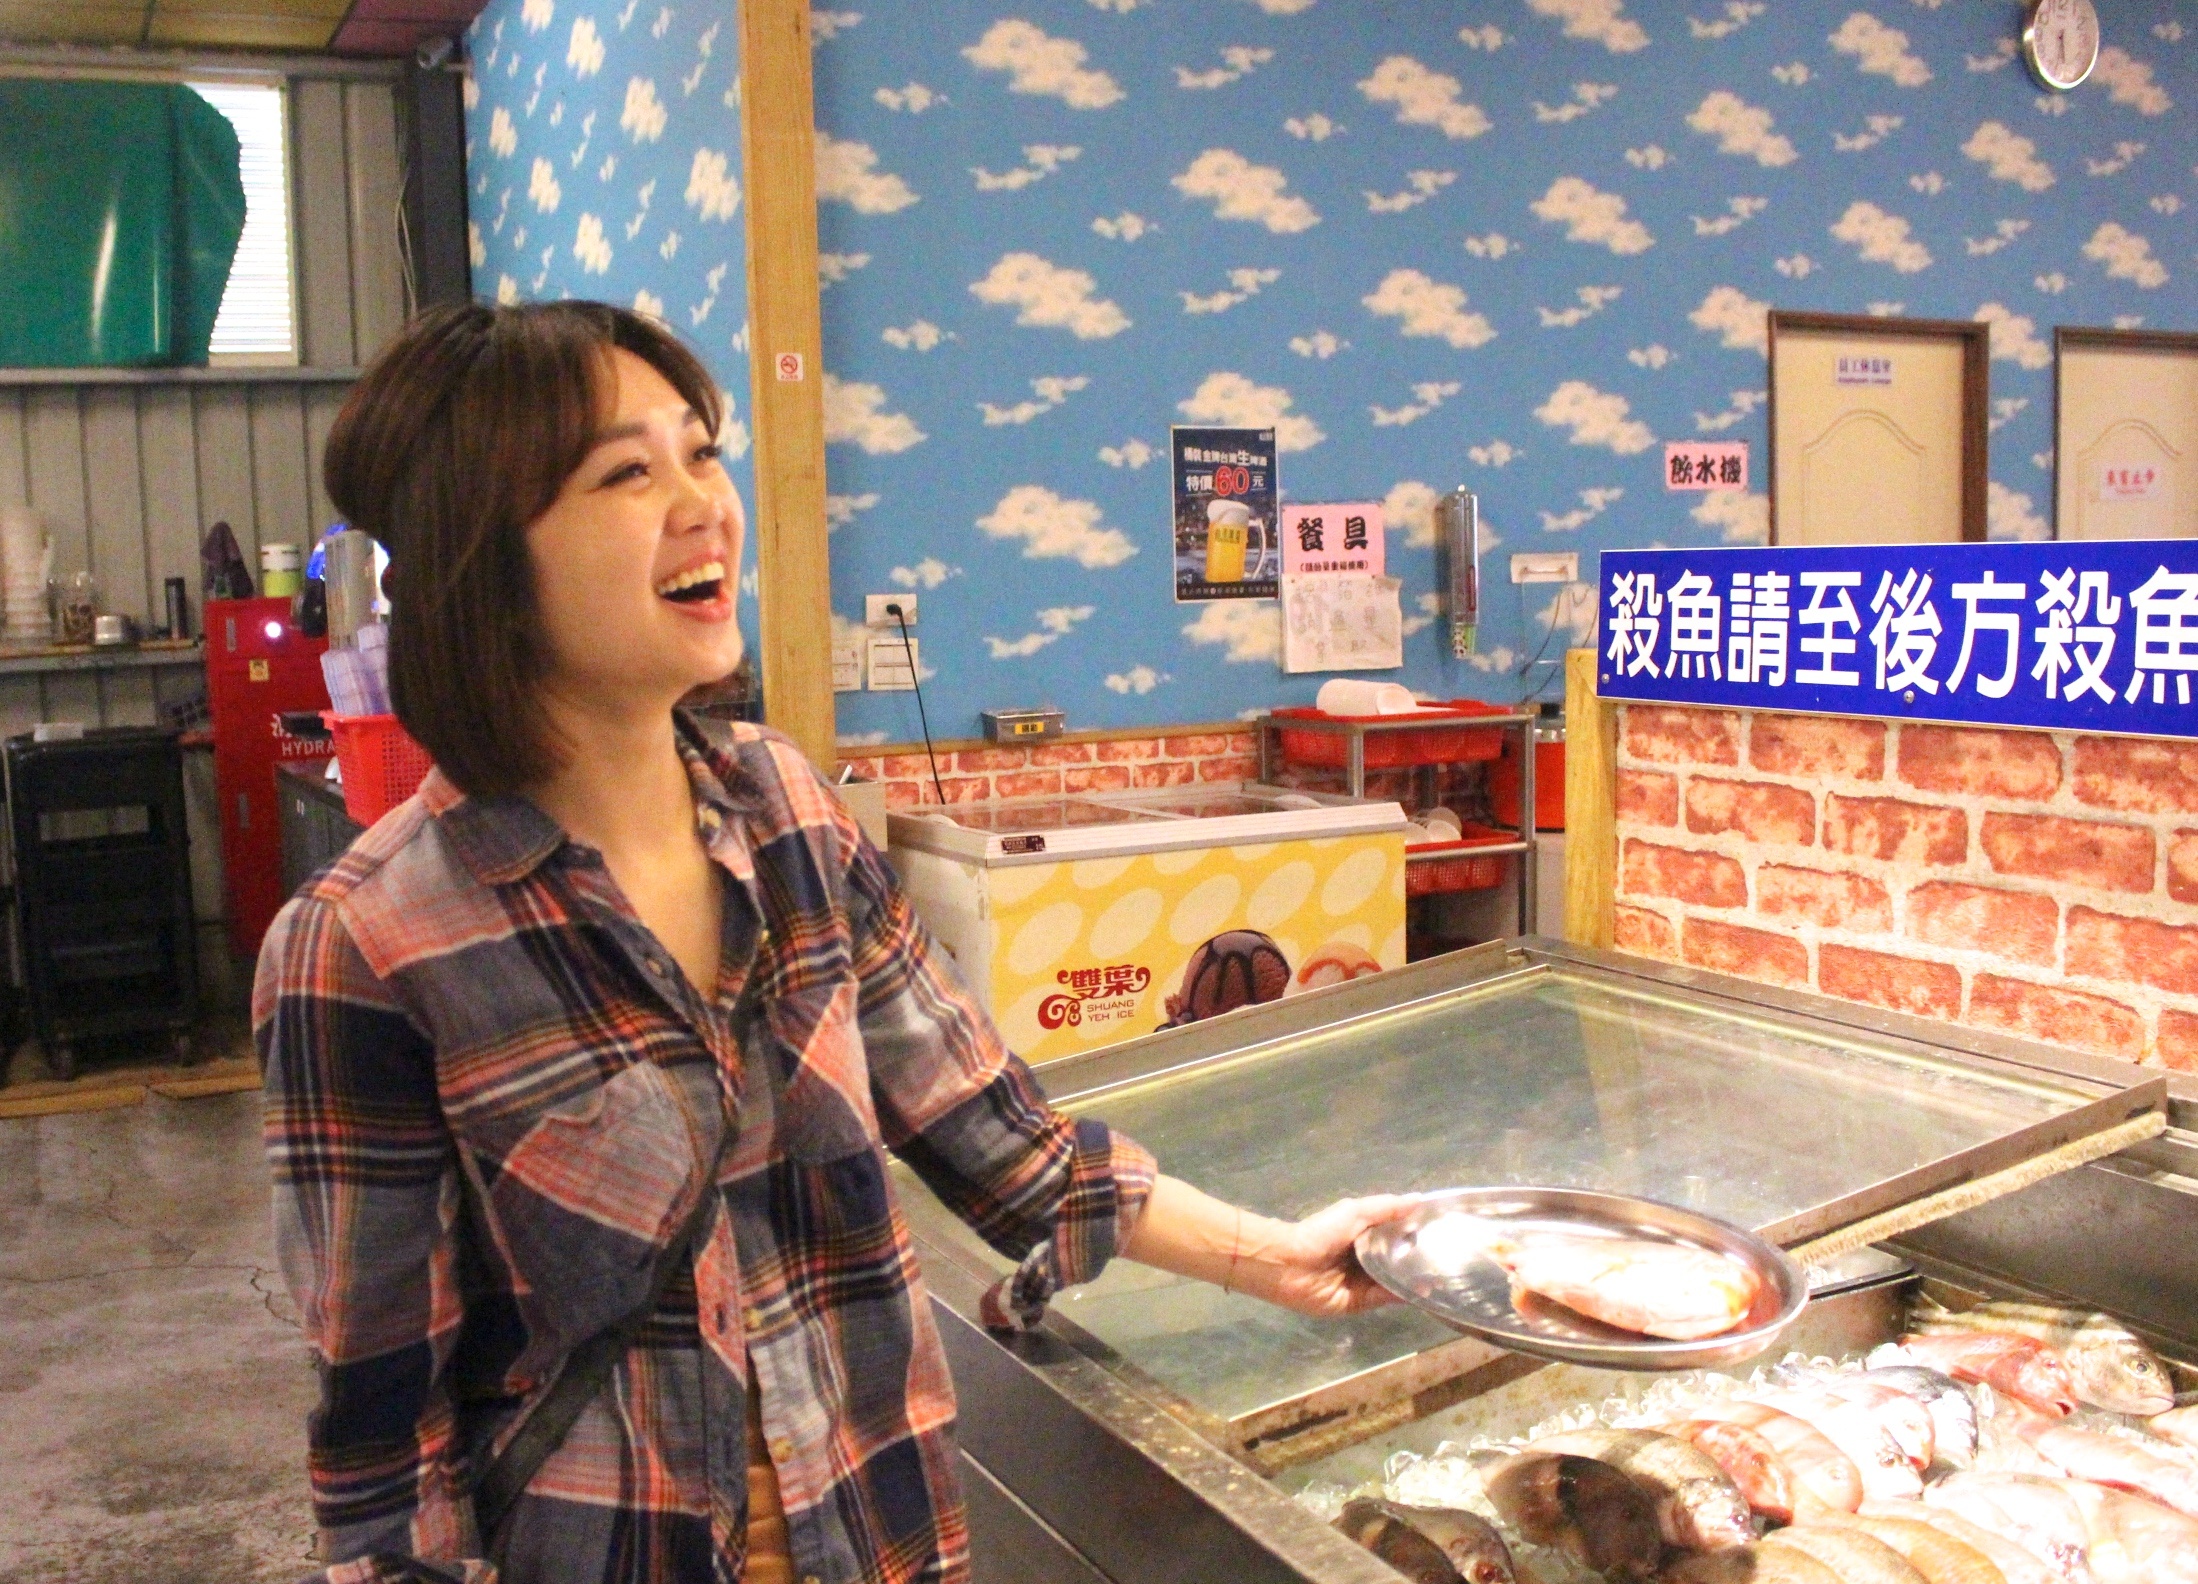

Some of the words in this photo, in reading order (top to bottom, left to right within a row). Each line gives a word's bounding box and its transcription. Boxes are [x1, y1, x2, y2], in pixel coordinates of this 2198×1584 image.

[1670, 454, 1741, 484] 飲水機
[1297, 516, 1368, 551] 餐具
[1606, 565, 2198, 704] 殺魚請至後方殺魚
[1058, 964, 1150, 1003] 雙葉
[1087, 999, 1135, 1013] SHUANG
[1088, 1013, 1110, 1022] YEH
[1117, 1009, 1135, 1020] ICE
